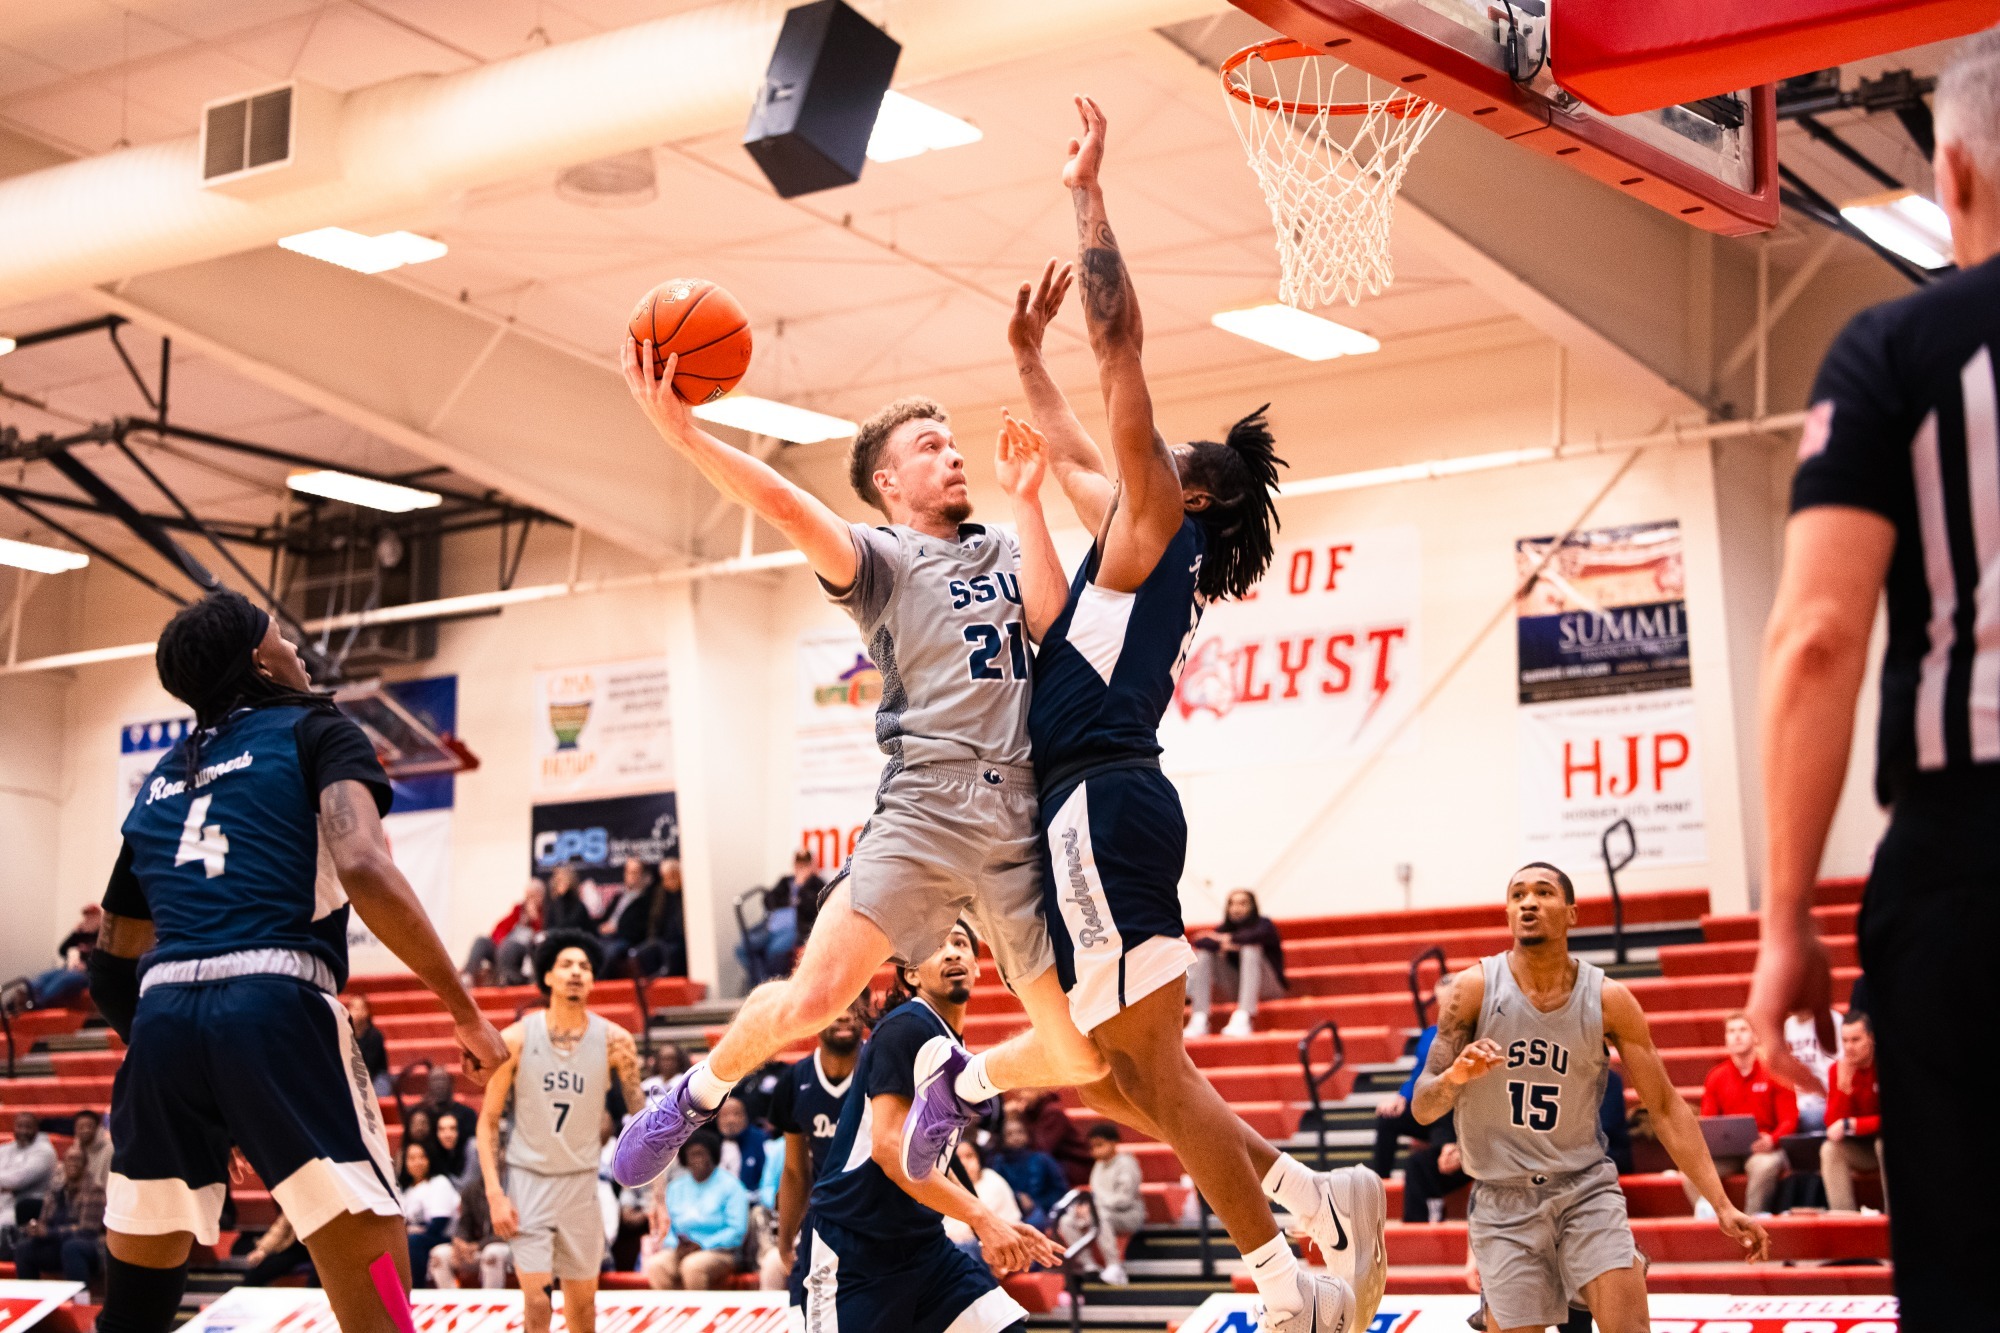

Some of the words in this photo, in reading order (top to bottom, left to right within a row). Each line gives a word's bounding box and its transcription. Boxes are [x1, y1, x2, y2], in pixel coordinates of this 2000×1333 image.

[948, 571, 1022, 612] SSU
[1288, 542, 1354, 595] OF
[1559, 602, 1688, 650] SUMMI
[962, 620, 1028, 683] 21
[1563, 732, 1690, 799] HJP
[174, 793, 229, 879] 4
[1062, 827, 1108, 948] Roadrunners
[543, 1070, 585, 1094] SSU
[1506, 1038, 1569, 1077] SSU
[552, 1102, 570, 1133] 7
[813, 1113, 840, 1138] Da
[1506, 1079, 1561, 1132] 15
